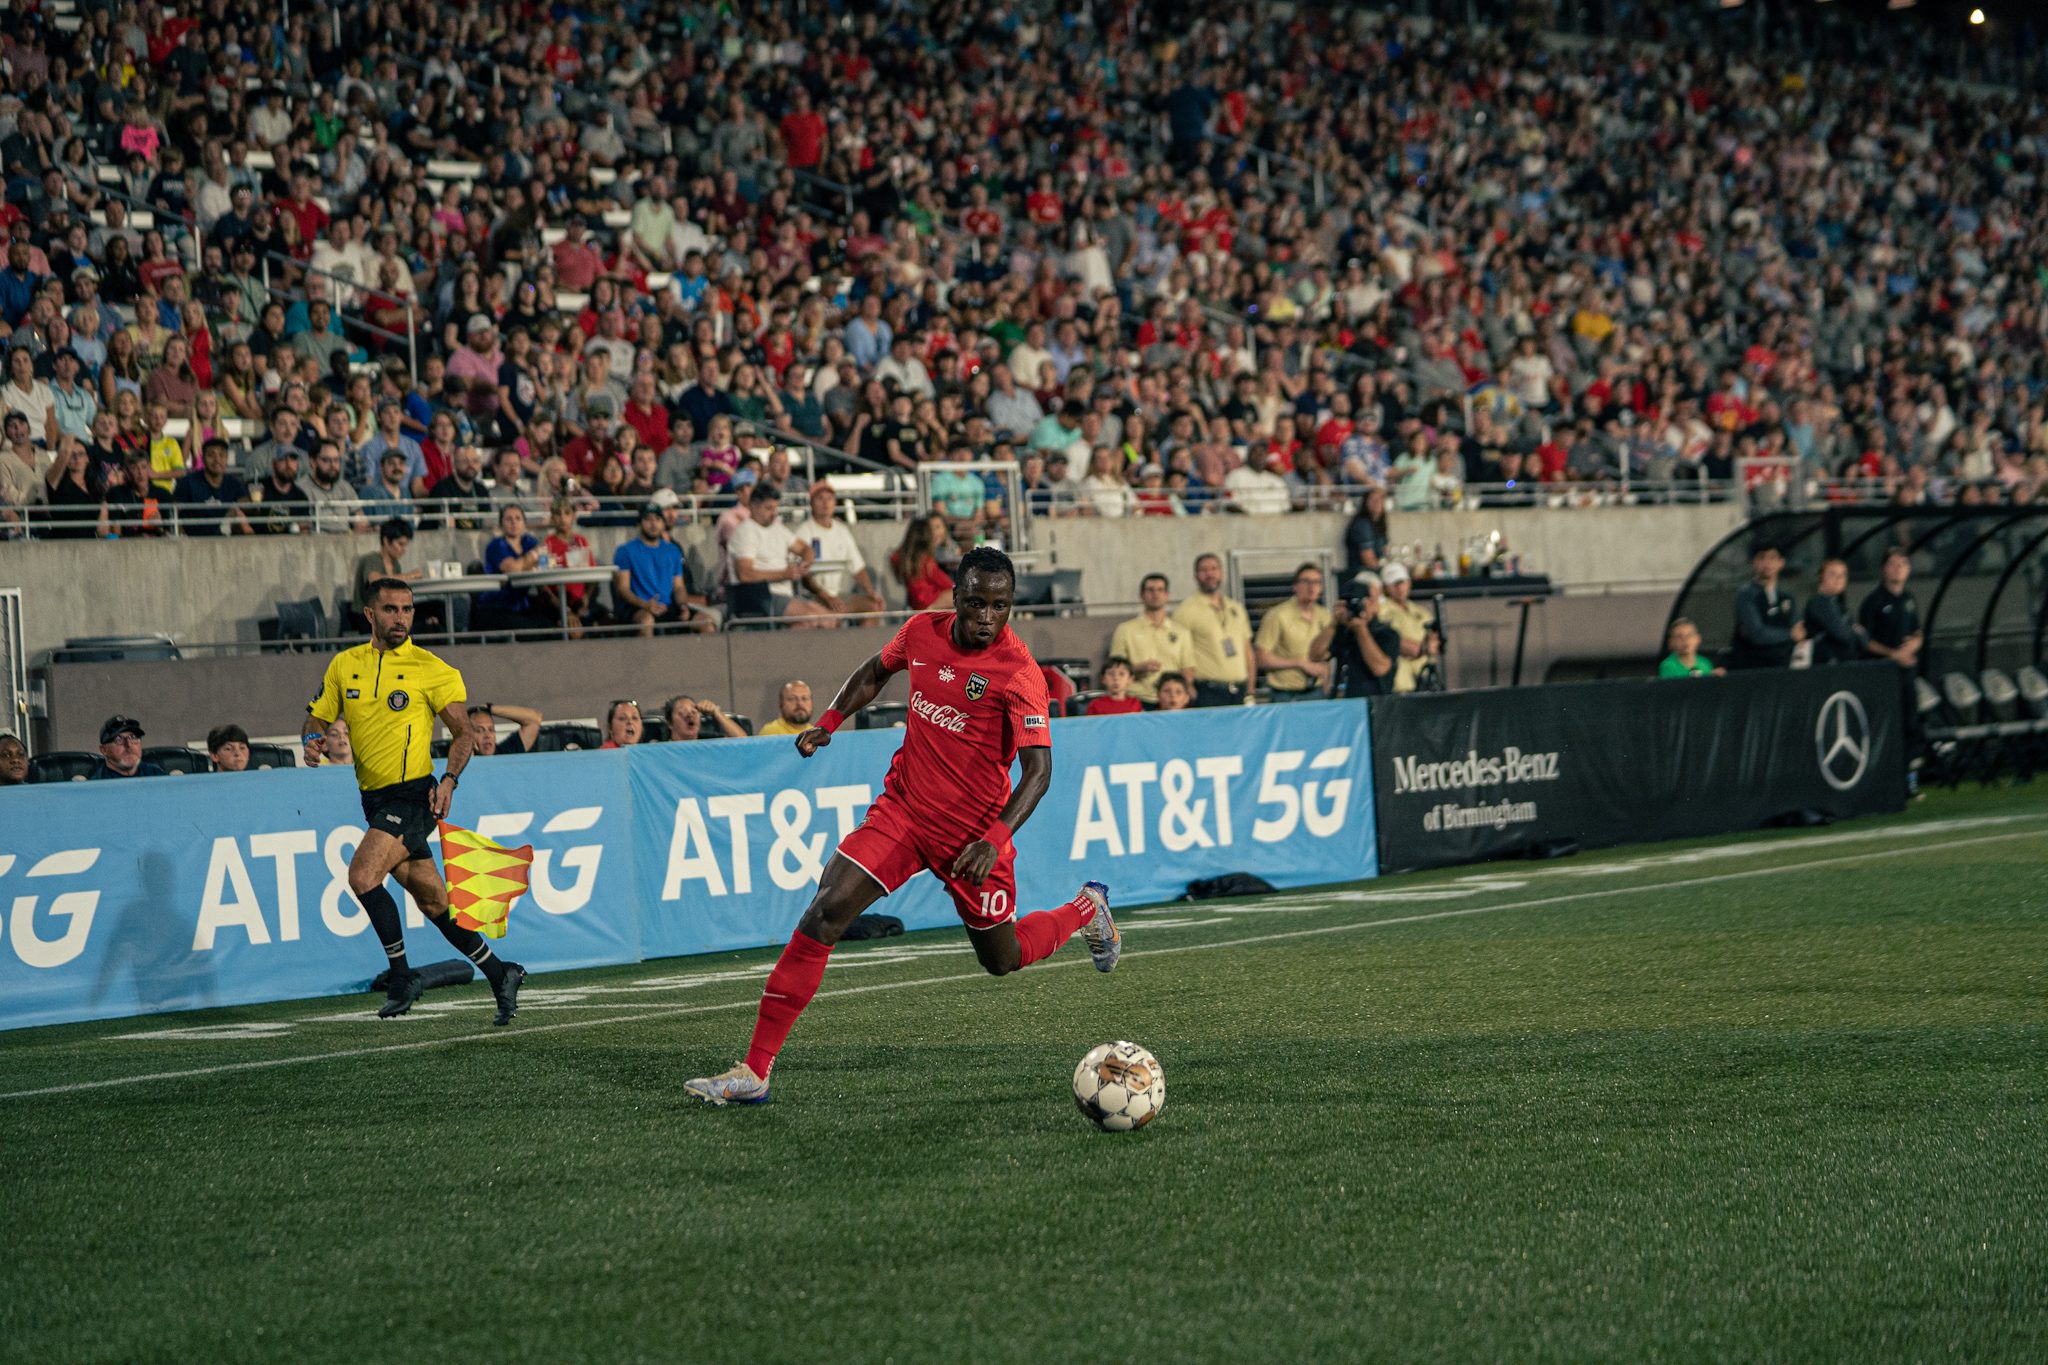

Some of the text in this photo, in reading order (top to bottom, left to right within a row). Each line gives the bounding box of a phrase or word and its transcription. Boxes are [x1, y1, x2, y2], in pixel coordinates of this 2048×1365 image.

[911, 691, 970, 733] Coca-Cola
[1393, 746, 1560, 794] Mercedes-Benz
[1069, 746, 1352, 860] AT&T 5G
[1423, 798, 1538, 832] of Birmingham
[0, 848, 101, 968] G
[980, 889, 1007, 917] 10
